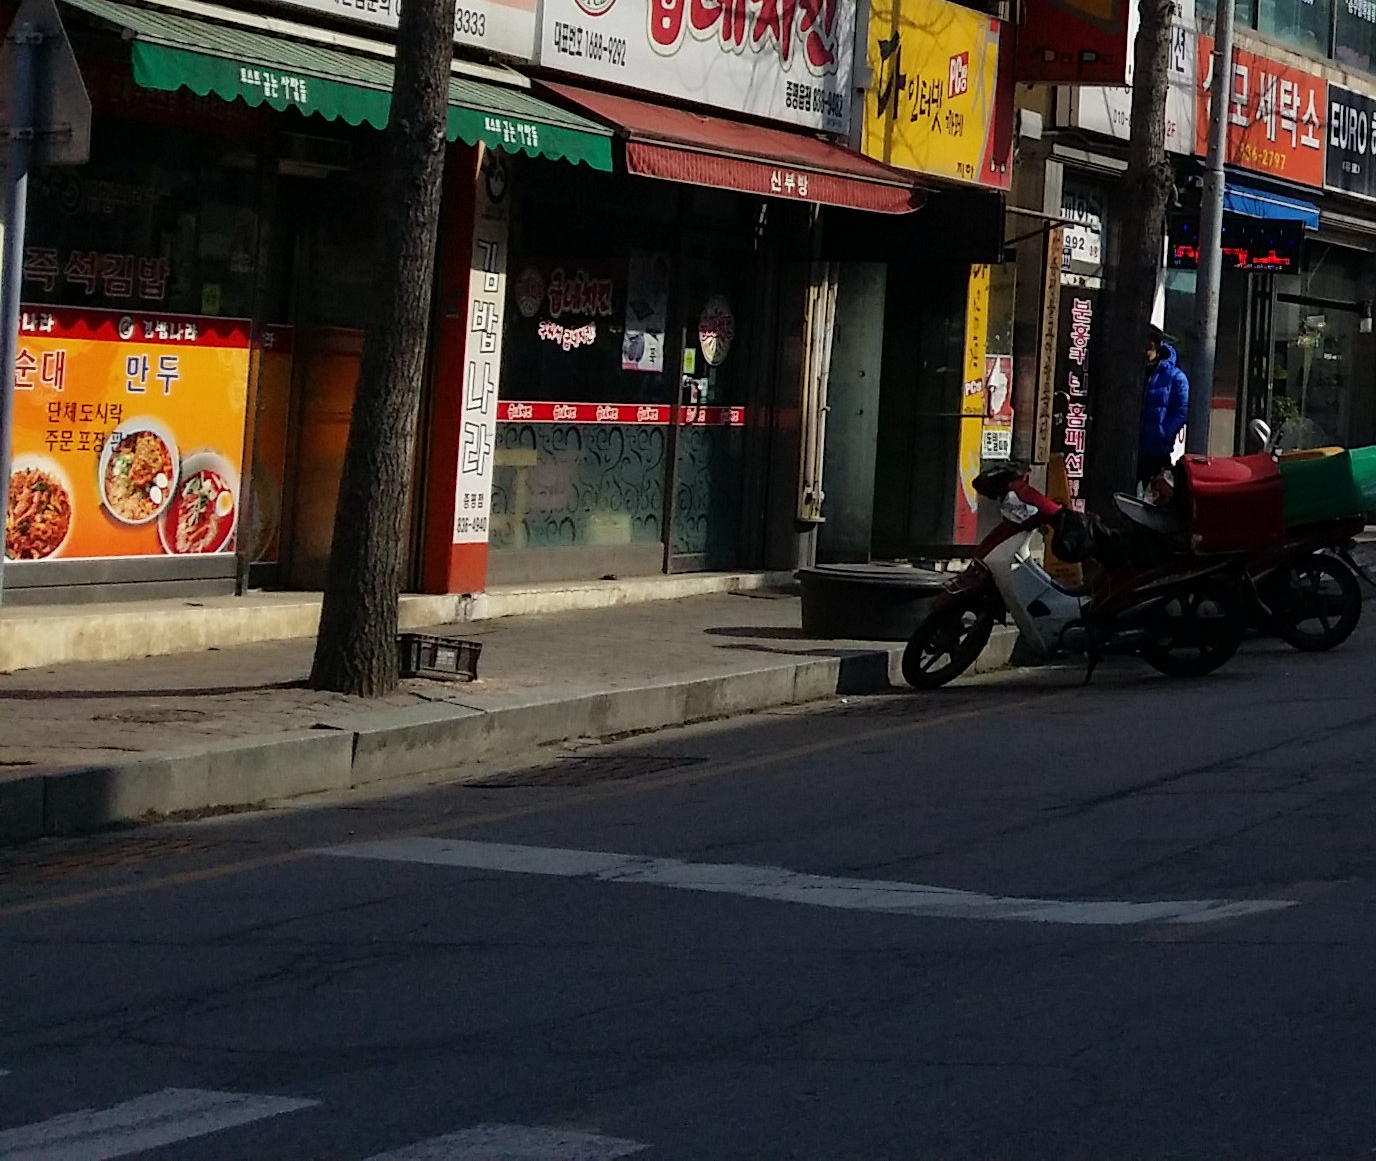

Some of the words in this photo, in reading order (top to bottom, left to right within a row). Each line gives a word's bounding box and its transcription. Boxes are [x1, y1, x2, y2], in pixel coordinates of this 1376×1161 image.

[1255, 70, 1321, 150] 세탁소
[1330, 101, 1368, 155] EURO
[770, 170, 810, 197] 신부방
[126, 354, 180, 396] 만두
